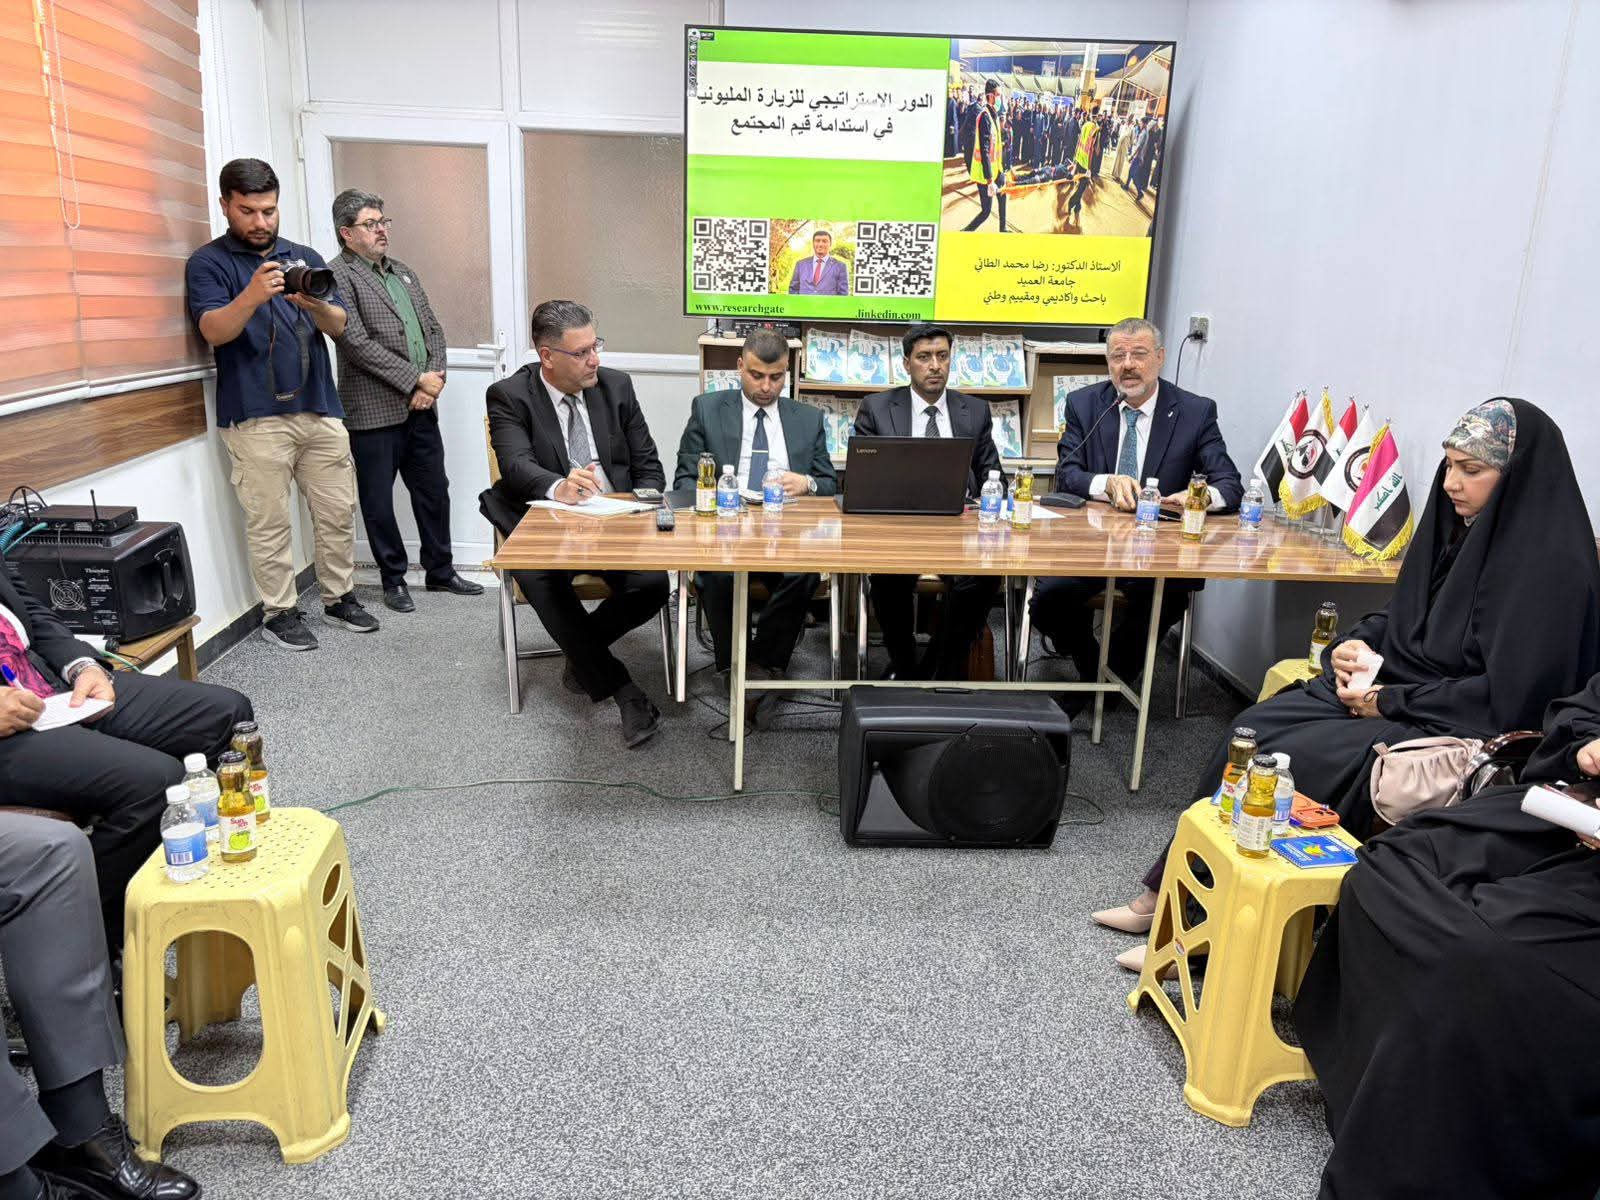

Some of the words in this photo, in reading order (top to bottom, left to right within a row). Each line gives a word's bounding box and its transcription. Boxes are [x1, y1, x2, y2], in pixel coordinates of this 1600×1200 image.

[696, 85, 752, 105] المليوني
[757, 87, 805, 108] للزيارة
[808, 90, 892, 112] الاستراتيجي
[898, 93, 933, 112] الدور
[731, 115, 785, 136] المجتمع
[790, 114, 811, 136] قيم
[815, 114, 869, 133] استدامة
[873, 117, 894, 140] في
[1003, 260, 1030, 269] محمد
[1032, 259, 1049, 272] رضا
[1017, 275, 1046, 287] العميد
[1047, 275, 1076, 288] جامعة
[983, 289, 1007, 305] وطني
[1042, 291, 1079, 306] واكاديمي
[1080, 293, 1107, 306] باحث
[695, 302, 785, 314] www.researchgate
